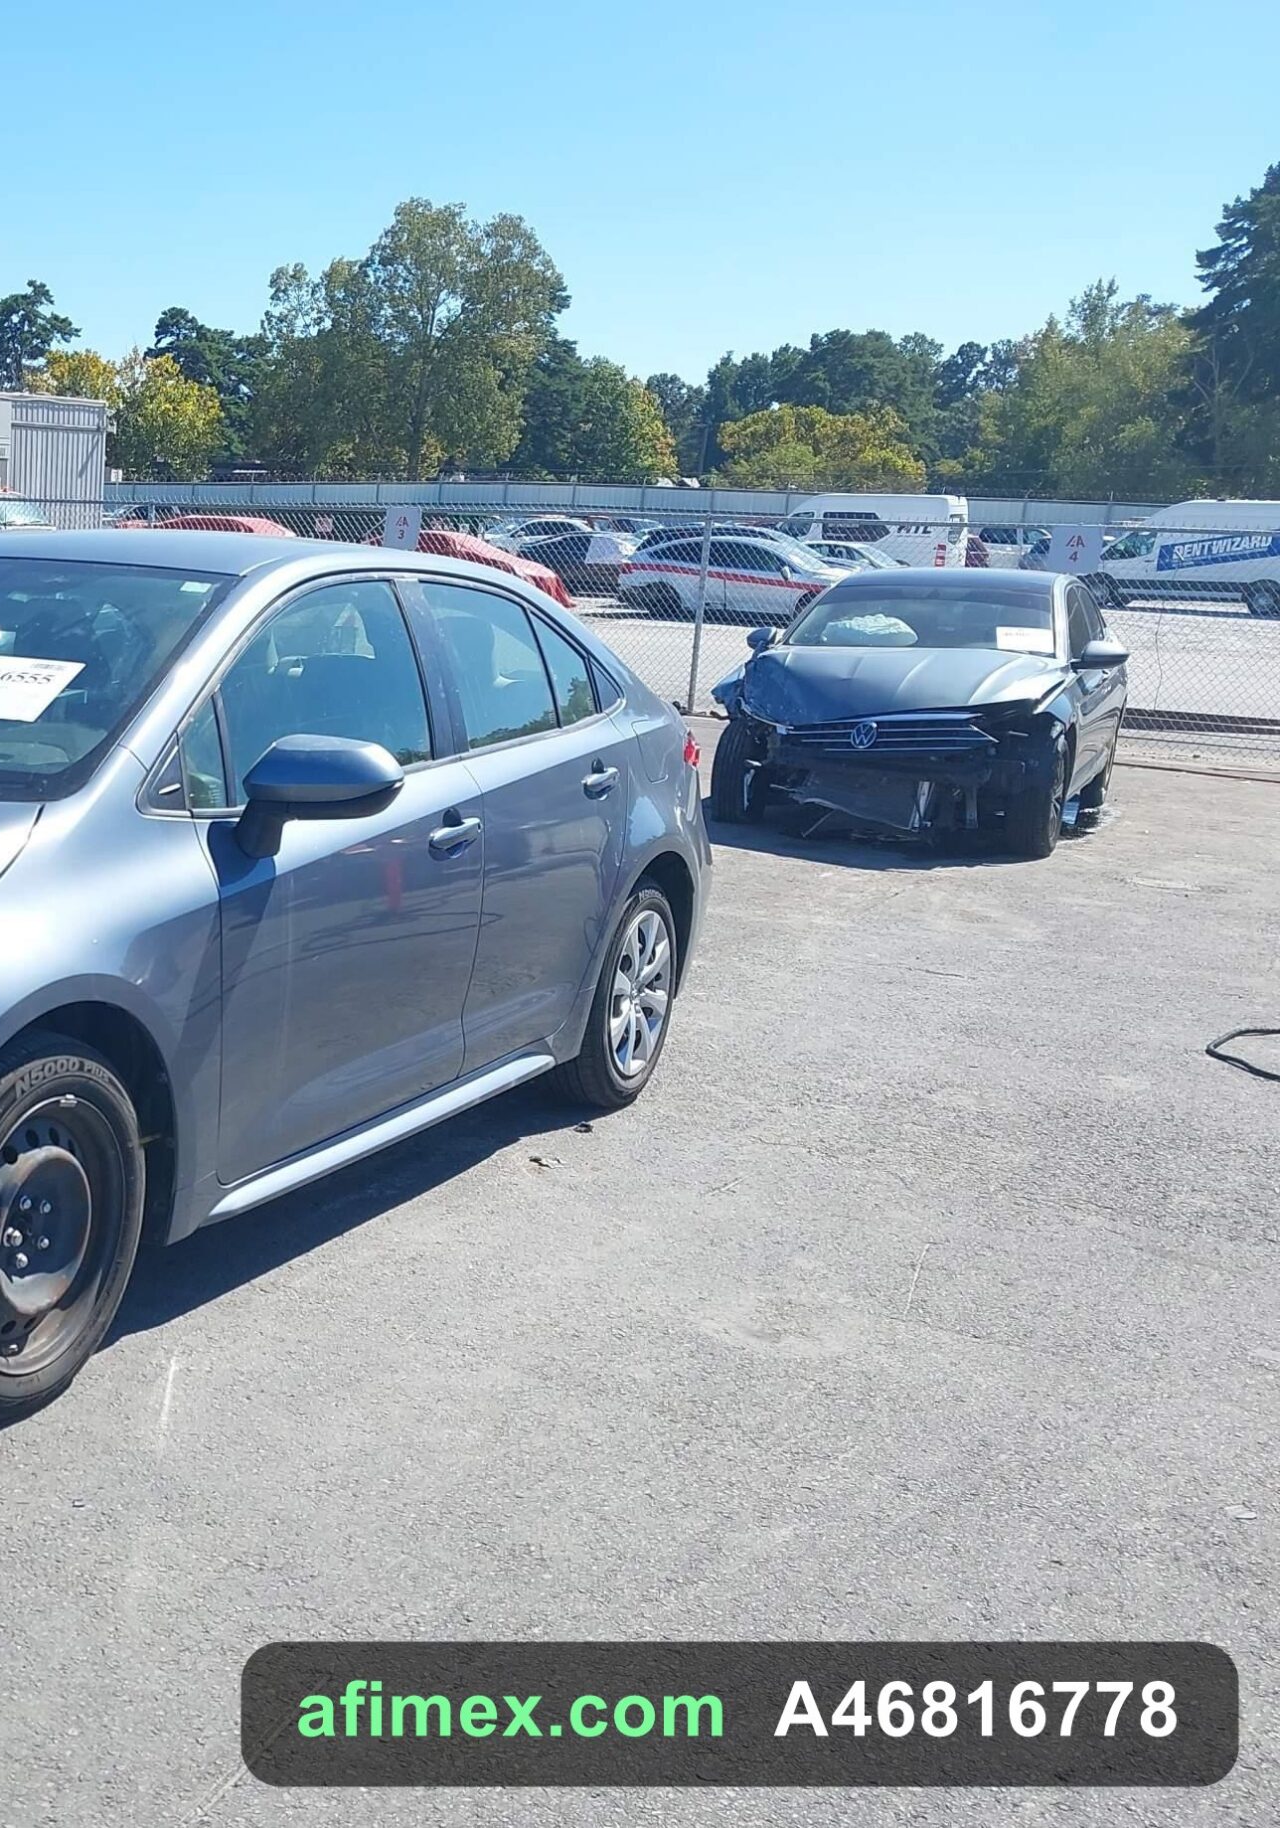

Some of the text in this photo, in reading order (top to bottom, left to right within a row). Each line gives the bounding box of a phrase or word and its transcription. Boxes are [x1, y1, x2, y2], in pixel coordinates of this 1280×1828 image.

[397, 529, 405, 540] 3
[1069, 551, 1079, 562] 4
[15, 1058, 81, 1100] N5000
